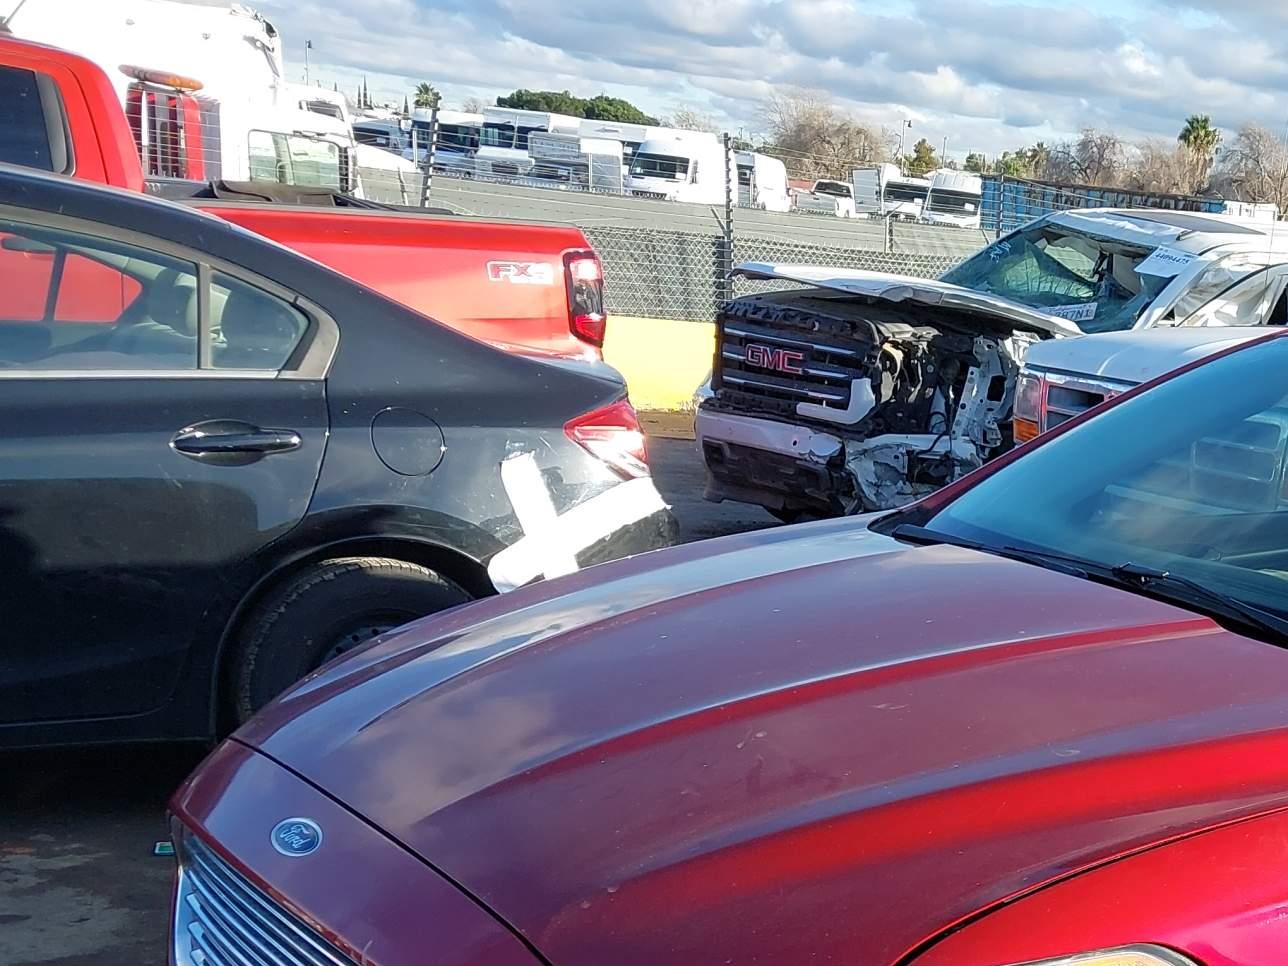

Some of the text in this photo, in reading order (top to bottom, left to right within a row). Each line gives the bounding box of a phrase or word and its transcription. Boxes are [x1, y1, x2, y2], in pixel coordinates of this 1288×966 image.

[487, 261, 554, 284] FX
[745, 344, 803, 374] GMC
[279, 824, 311, 849] Ford
